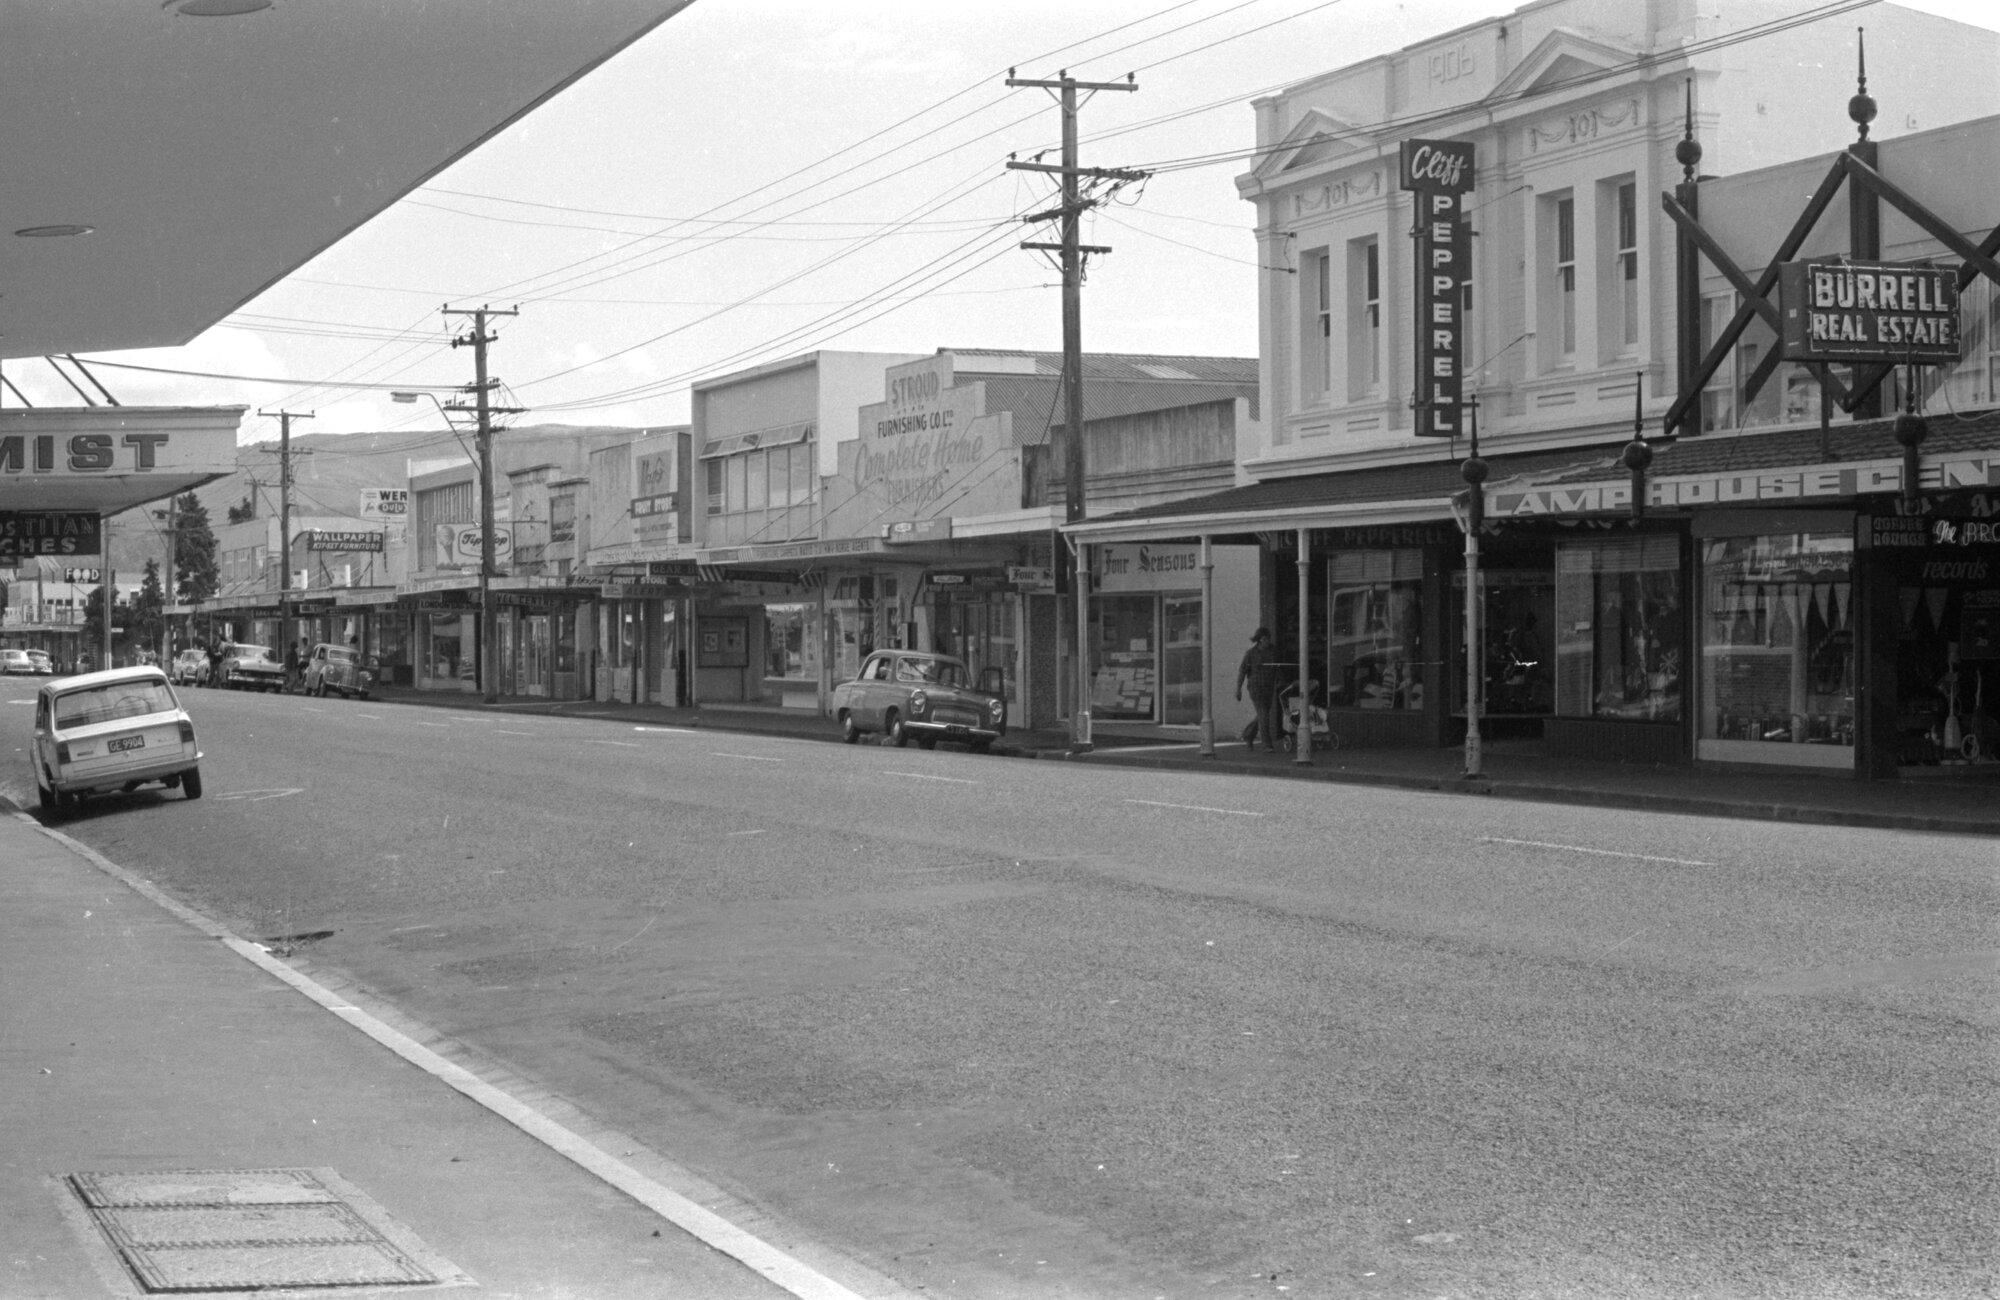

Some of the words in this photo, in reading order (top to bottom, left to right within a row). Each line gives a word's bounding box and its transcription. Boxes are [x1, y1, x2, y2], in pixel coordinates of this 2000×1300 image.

[1427, 44, 1475, 89] 1906
[1411, 145, 1468, 186] Cliff
[1815, 272, 1949, 312] BURRELL
[1432, 195, 1453, 431] PEPPERELL
[1812, 313, 1868, 341] REAL
[1877, 315, 1951, 344] ESTATE
[891, 370, 939, 406] STROUD
[877, 414, 928, 439] FURNISHING
[854, 433, 930, 494] Complete
[931, 431, 983, 471] Home
[24, 514, 95, 537] TITAN
[313, 533, 381, 543] WALLPAPER
[339, 542, 380, 550] FURNITURE
[494, 534, 508, 546] op
[1105, 548, 1129, 576] Four
[1138, 545, 1196, 573] Seasons
[1922, 556, 1989, 579] records
[66, 568, 99, 581] FOOD
[1012, 568, 1036, 581] Four
[110, 741, 122, 751] GE
